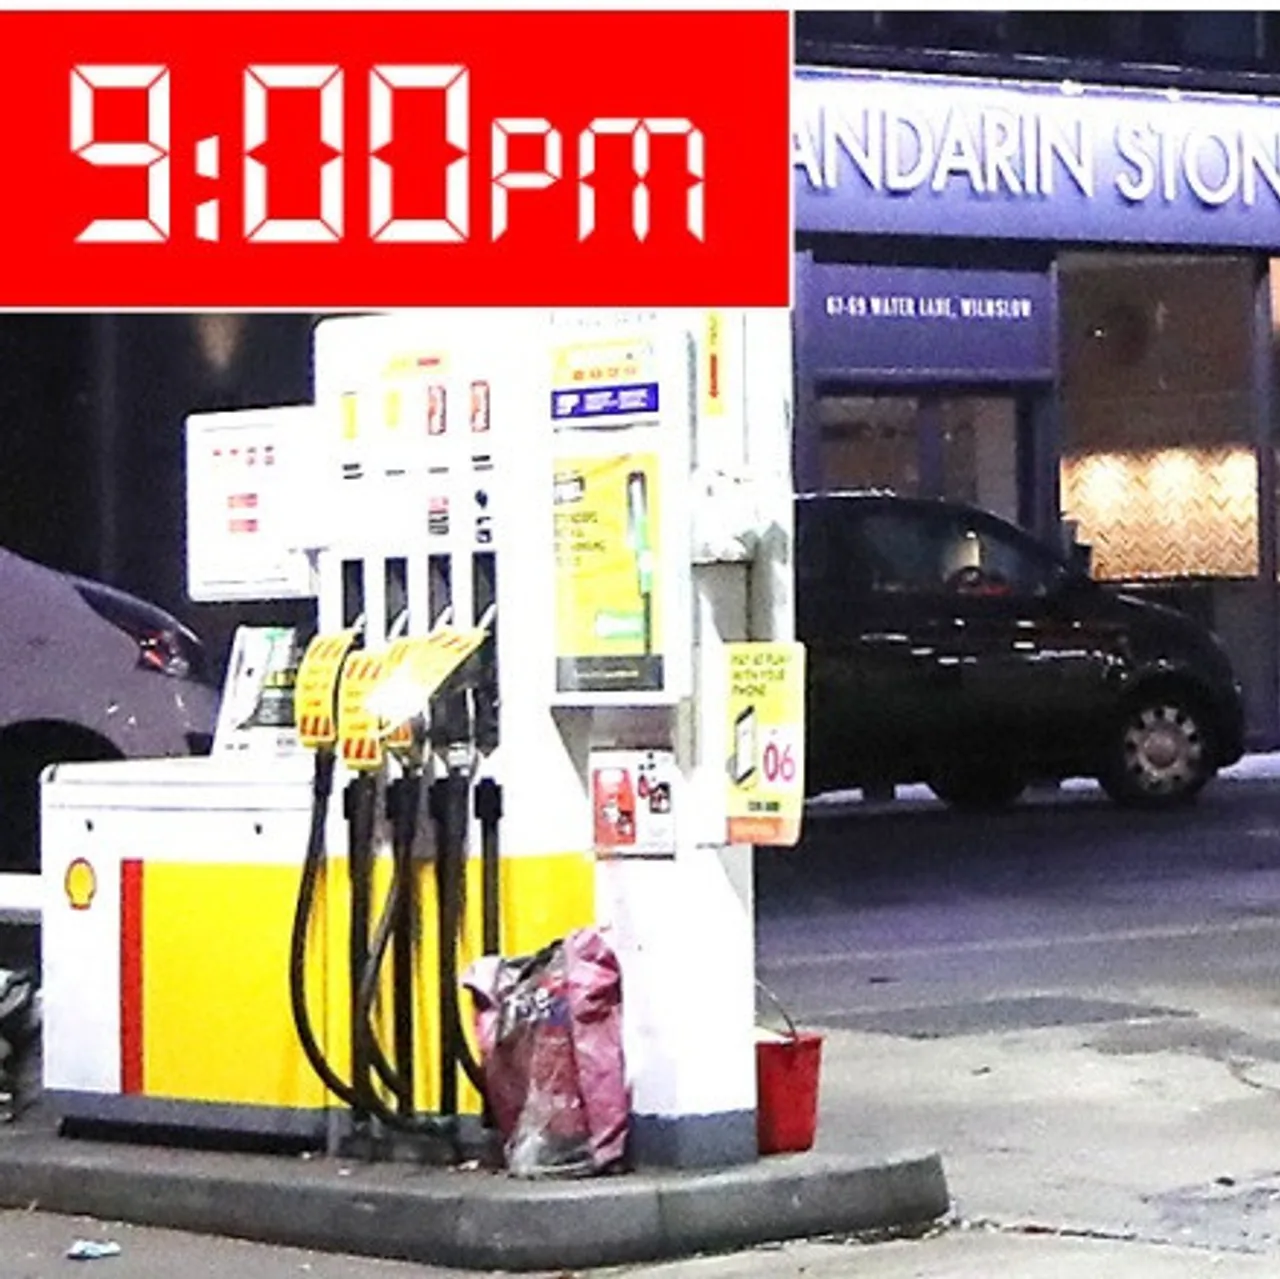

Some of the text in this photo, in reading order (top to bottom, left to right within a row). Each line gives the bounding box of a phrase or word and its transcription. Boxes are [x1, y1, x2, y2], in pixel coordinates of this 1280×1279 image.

[793, 104, 1095, 198] ANDARIN
[870, 297, 914, 316] WATER
[763, 743, 795, 782] 06
